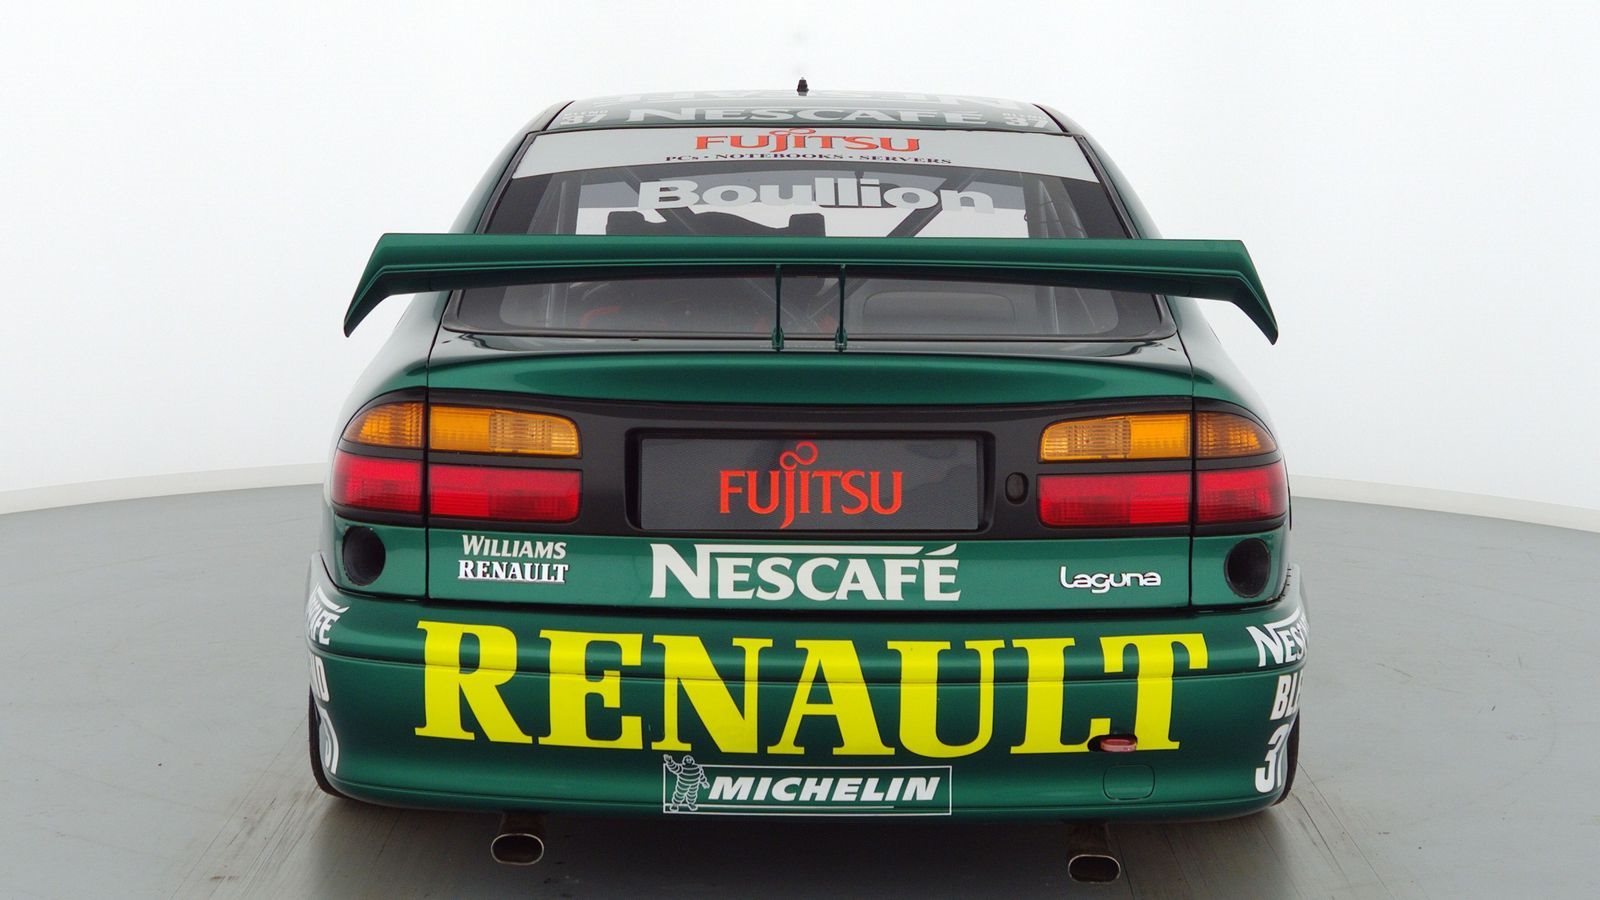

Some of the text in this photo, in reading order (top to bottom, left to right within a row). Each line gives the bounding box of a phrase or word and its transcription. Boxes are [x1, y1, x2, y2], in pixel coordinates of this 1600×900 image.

[694, 127, 921, 153] FUJITSU
[715, 152, 844, 160] NOTEBOOKS
[859, 154, 952, 164] SERVERS
[638, 176, 995, 214] Boullion
[719, 441, 904, 530] FUJITSU
[461, 533, 568, 560] WILLIAMS
[457, 559, 569, 584] RENAULT
[650, 543, 962, 601] NESCAFÉ
[414, 620, 1209, 759] RENAULT
[707, 776, 940, 801] MICHELIN
